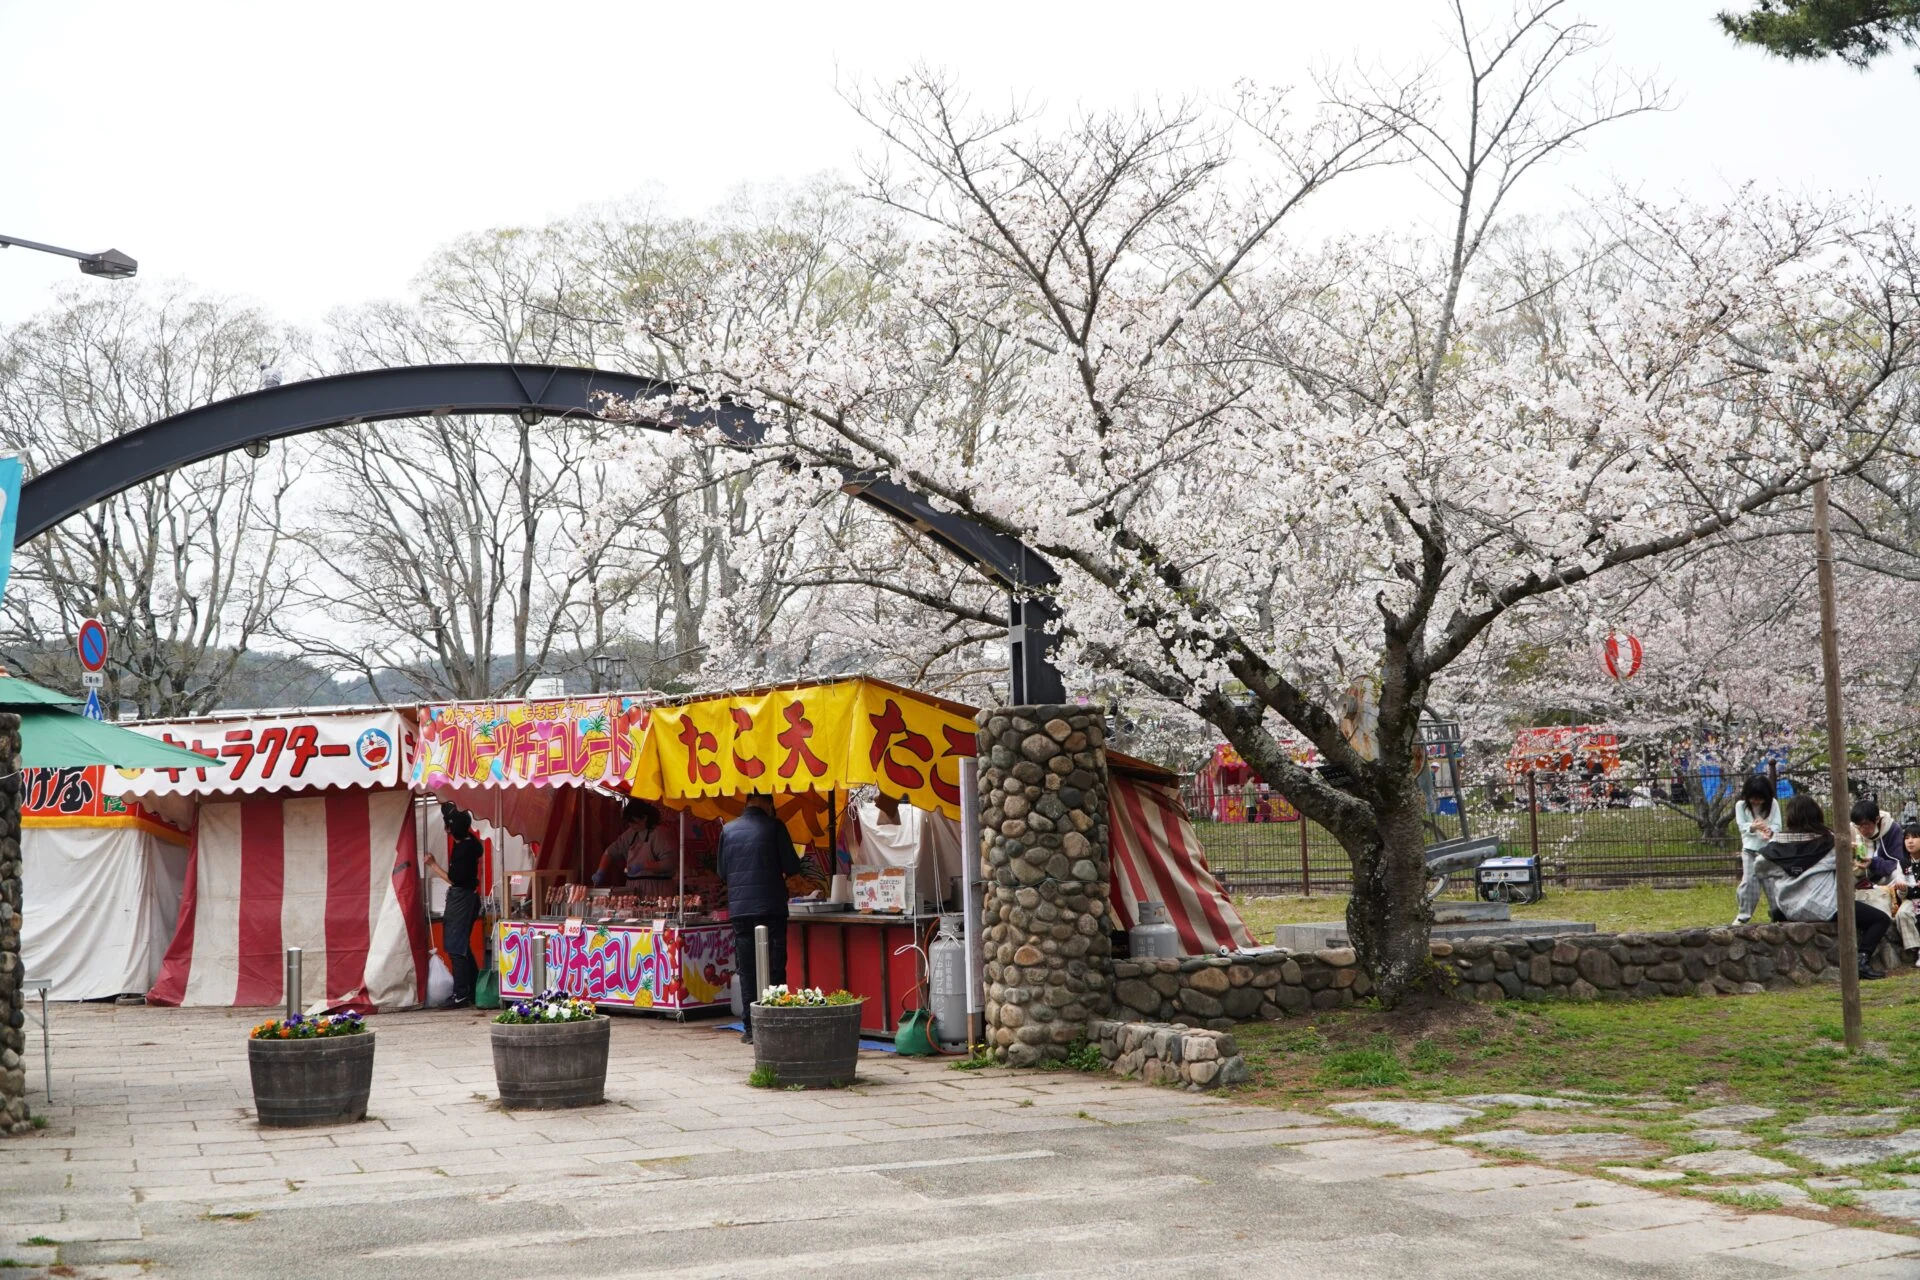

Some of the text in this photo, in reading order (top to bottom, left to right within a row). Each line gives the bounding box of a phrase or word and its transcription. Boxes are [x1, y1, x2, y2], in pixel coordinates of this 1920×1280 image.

[439, 716, 632, 780] フルーツチョコレート
